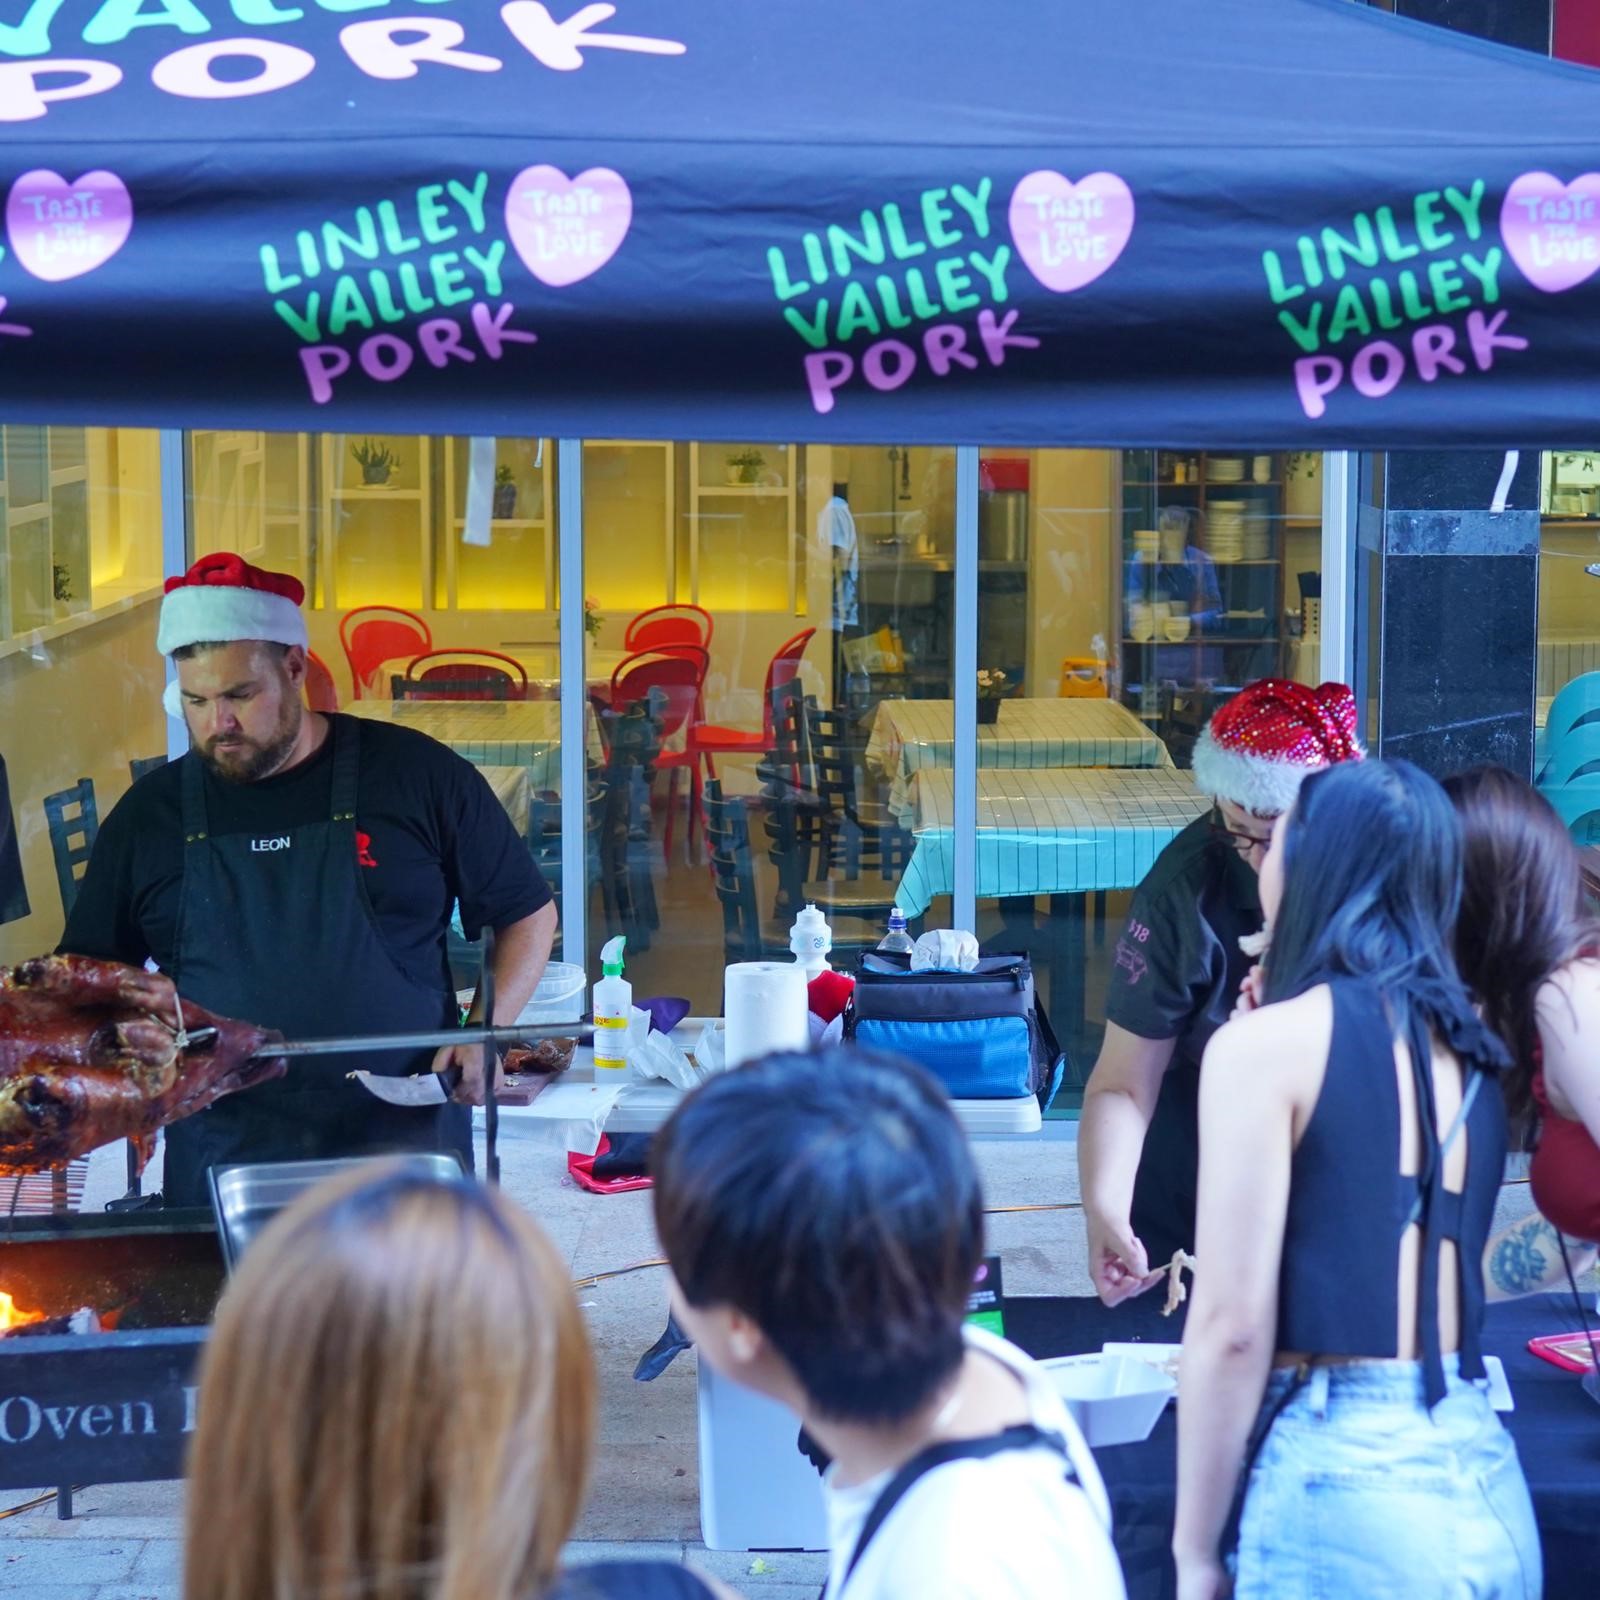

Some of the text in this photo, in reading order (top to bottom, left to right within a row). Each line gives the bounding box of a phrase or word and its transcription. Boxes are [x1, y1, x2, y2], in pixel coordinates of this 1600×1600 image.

[0, 0, 686, 121] PORK
[21, 191, 103, 222] TASTE
[259, 171, 488, 294] LINLEY
[522, 187, 603, 216] TASTE
[767, 177, 993, 302] LINLEY
[1024, 191, 1105, 219] TASTE
[1041, 230, 1107, 266] LOVE
[1262, 179, 1485, 305] LINLEY
[1514, 192, 1596, 223] TASTE
[1528, 233, 1598, 266] LOVE
[272, 239, 506, 342] VALLEY
[782, 245, 1011, 348] VALLEY
[1278, 246, 1502, 352] VALLEY
[300, 302, 537, 404] PORK
[804, 309, 1041, 413] PORK
[1293, 310, 1529, 420] PORK
[251, 836, 291, 852] LEON
[0, 1396, 157, 1443] Oven
